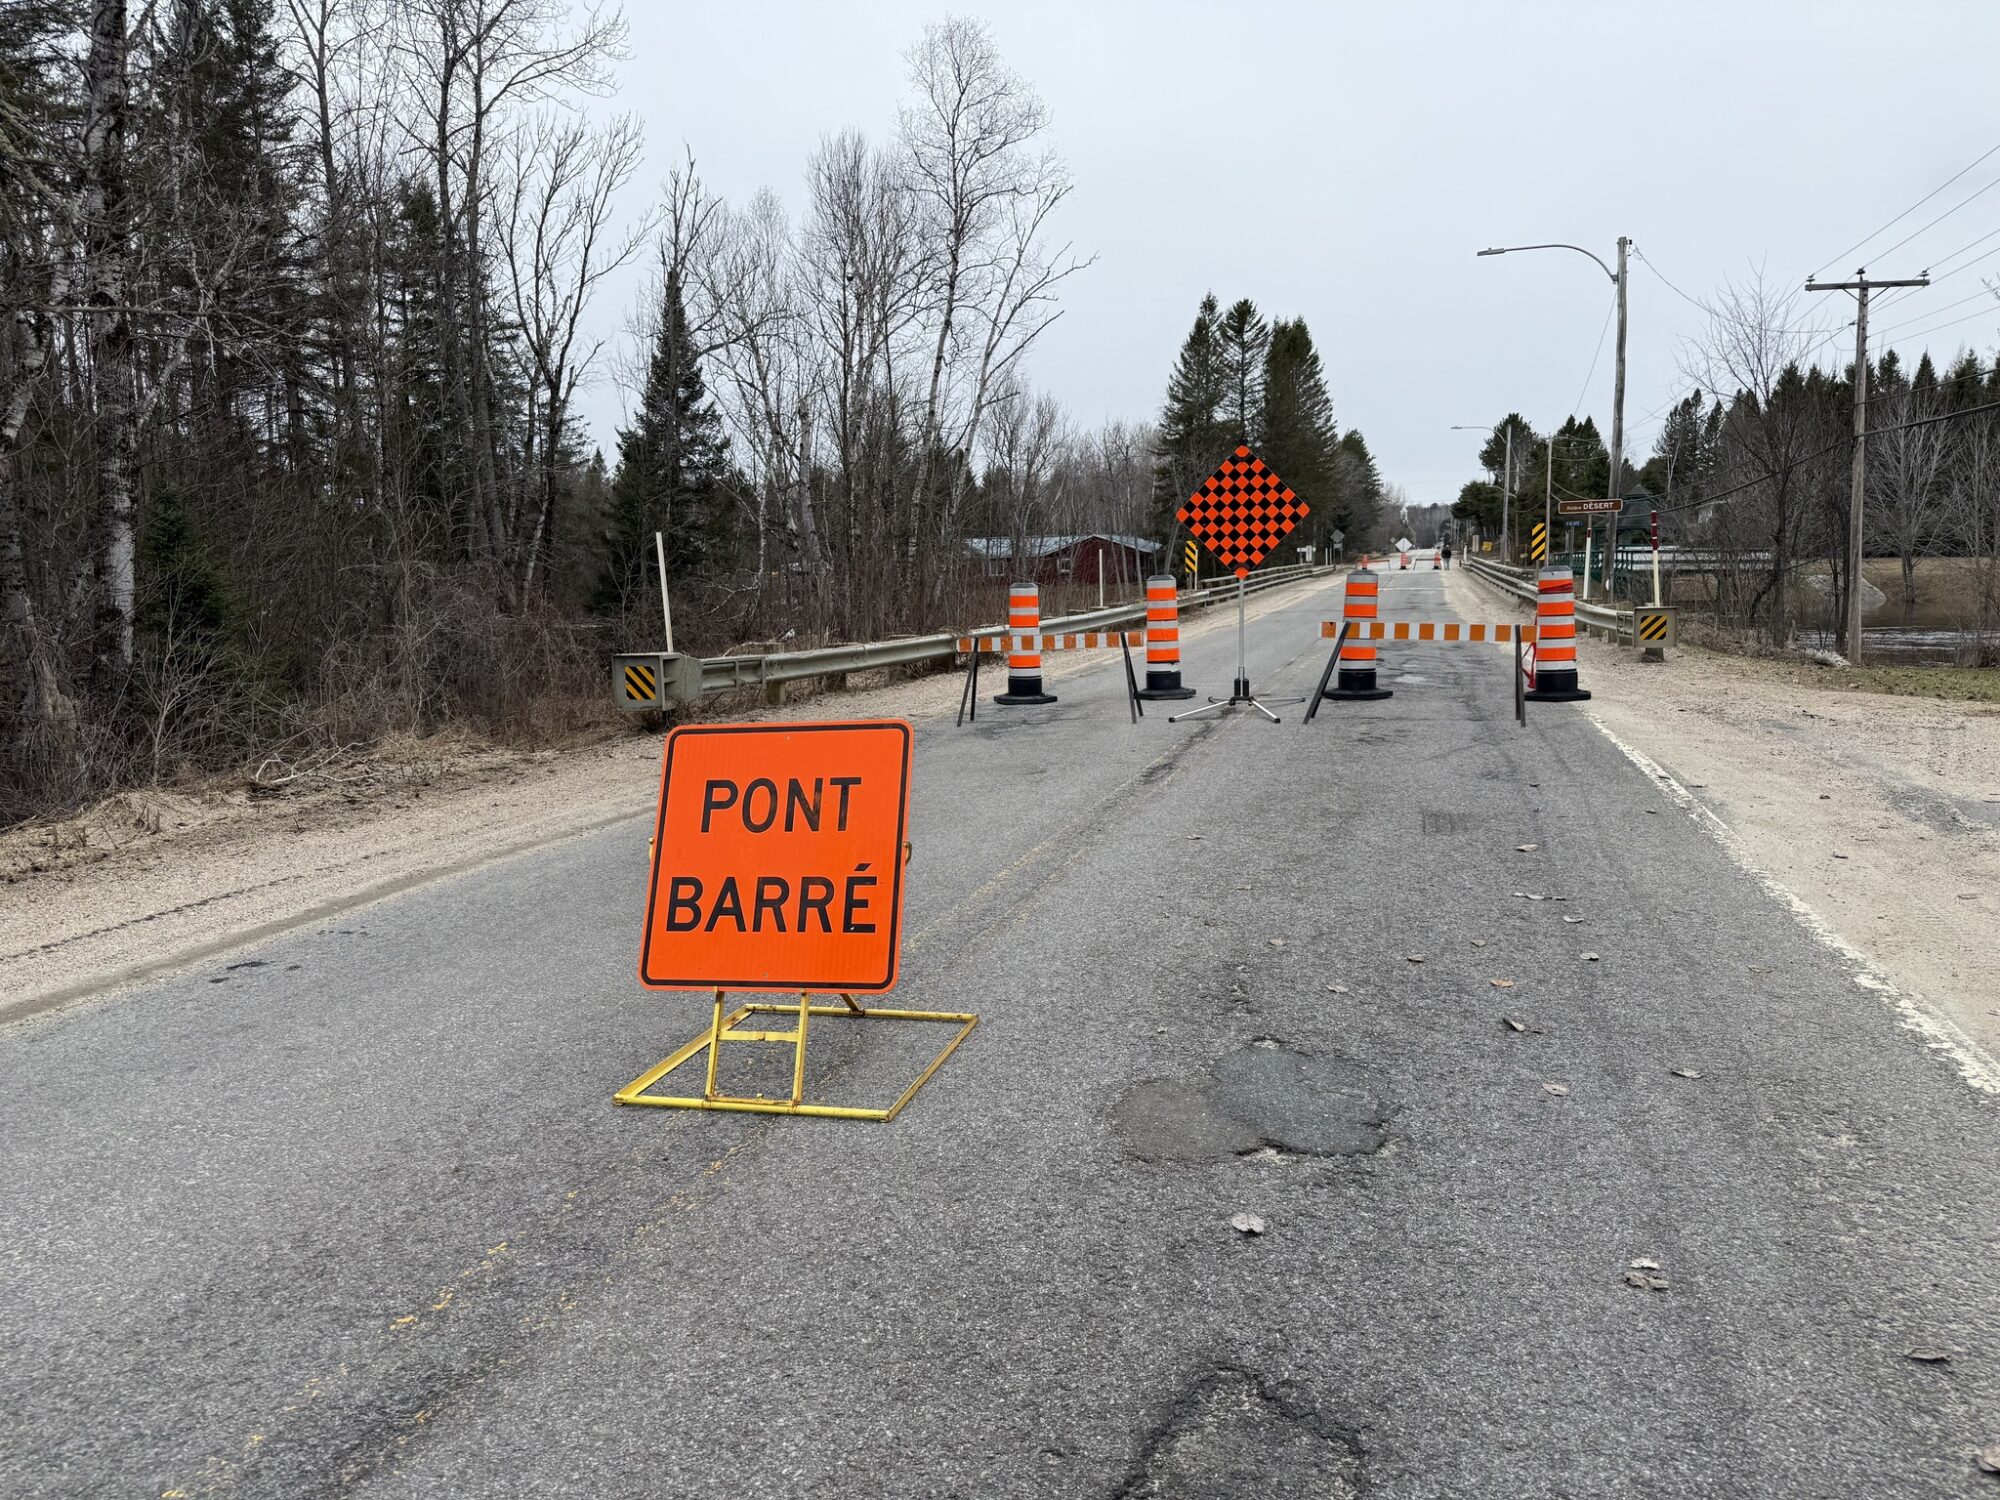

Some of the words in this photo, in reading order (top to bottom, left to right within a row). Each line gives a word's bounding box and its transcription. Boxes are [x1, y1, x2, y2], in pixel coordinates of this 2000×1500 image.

[1583, 502, 1614, 510] DÉSERT
[700, 777, 862, 833] PONT
[666, 863, 878, 933] BARRÉ
